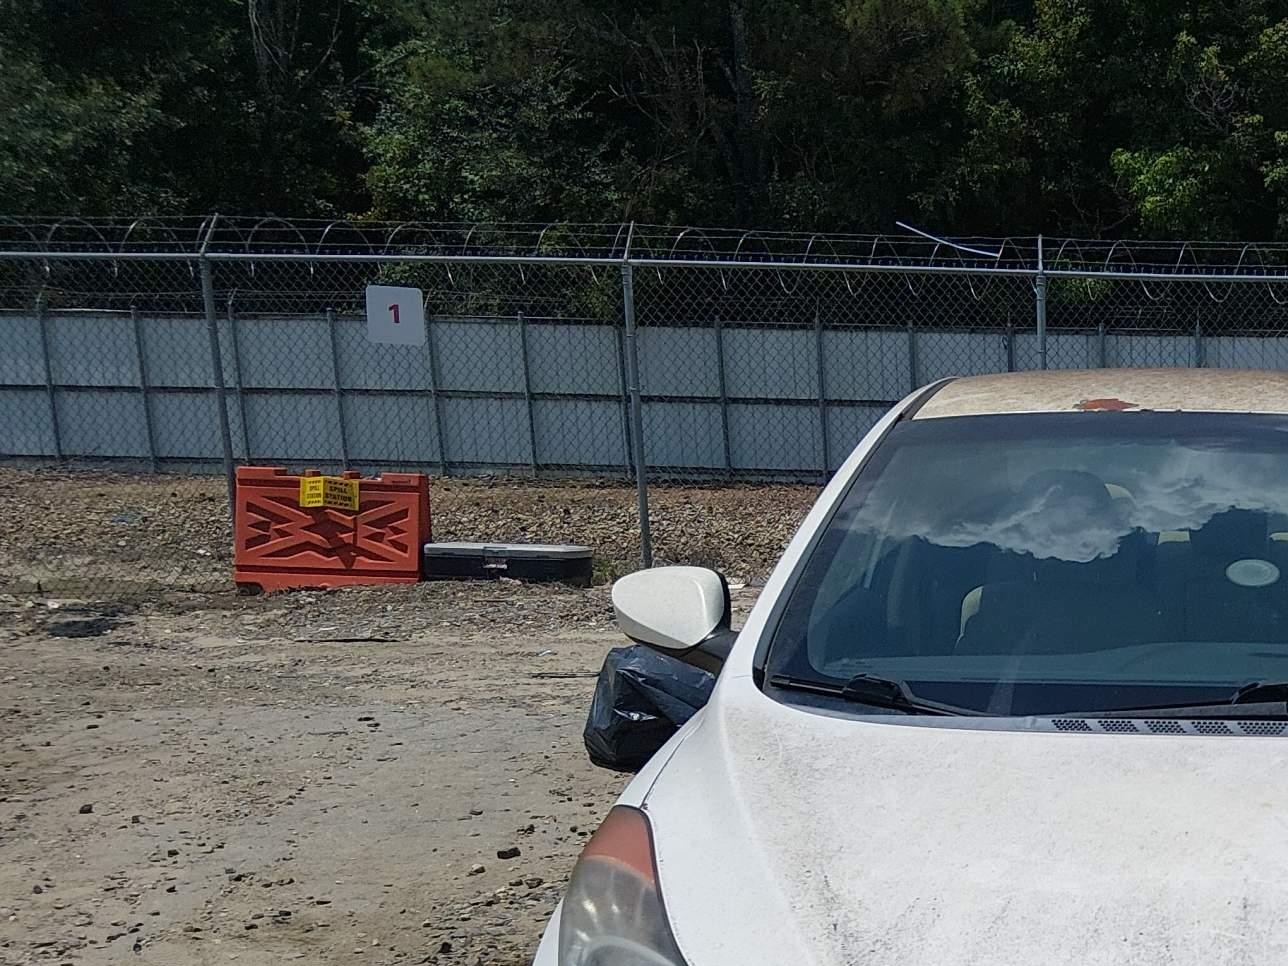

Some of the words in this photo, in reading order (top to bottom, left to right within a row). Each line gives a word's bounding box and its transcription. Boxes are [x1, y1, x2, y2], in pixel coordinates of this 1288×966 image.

[389, 304, 400, 323] 1
[329, 486, 348, 494] SPILL
[325, 493, 352, 502] STATION
